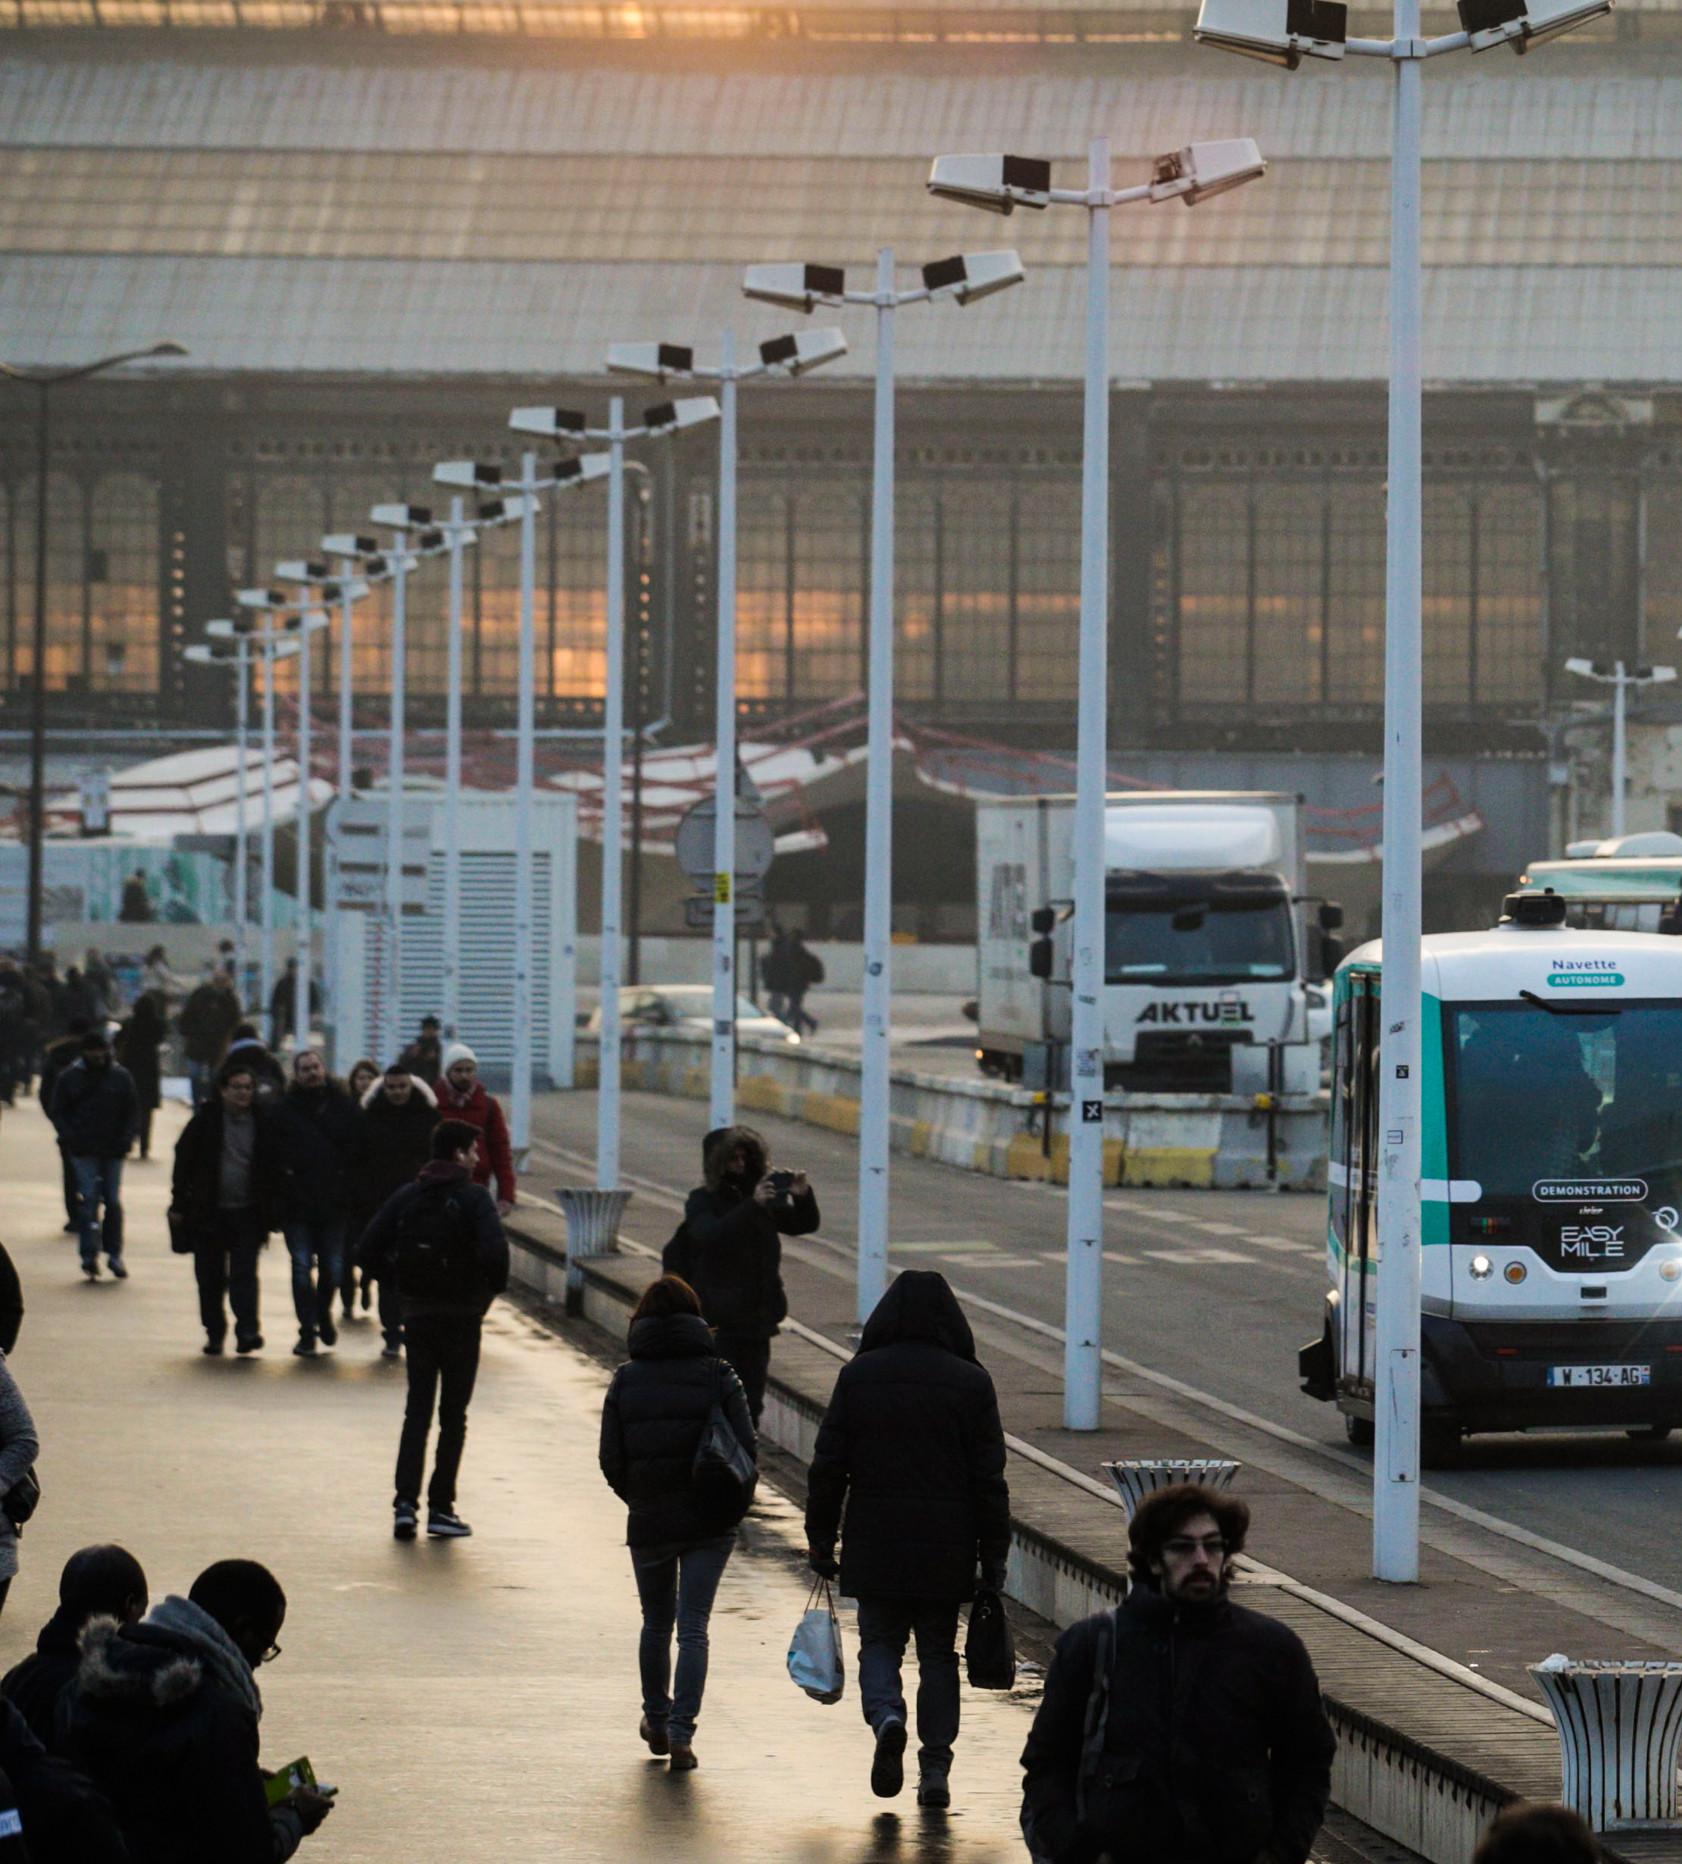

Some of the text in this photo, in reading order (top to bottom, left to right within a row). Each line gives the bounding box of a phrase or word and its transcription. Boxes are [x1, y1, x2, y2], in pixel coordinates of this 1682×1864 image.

[1552, 960, 1617, 970] Navette
[1554, 976, 1616, 985] AUTONOME
[1136, 1001, 1254, 1023] AKTUEL
[1561, 1226, 1624, 1242] EASY
[1561, 1241, 1624, 1257] MILE
